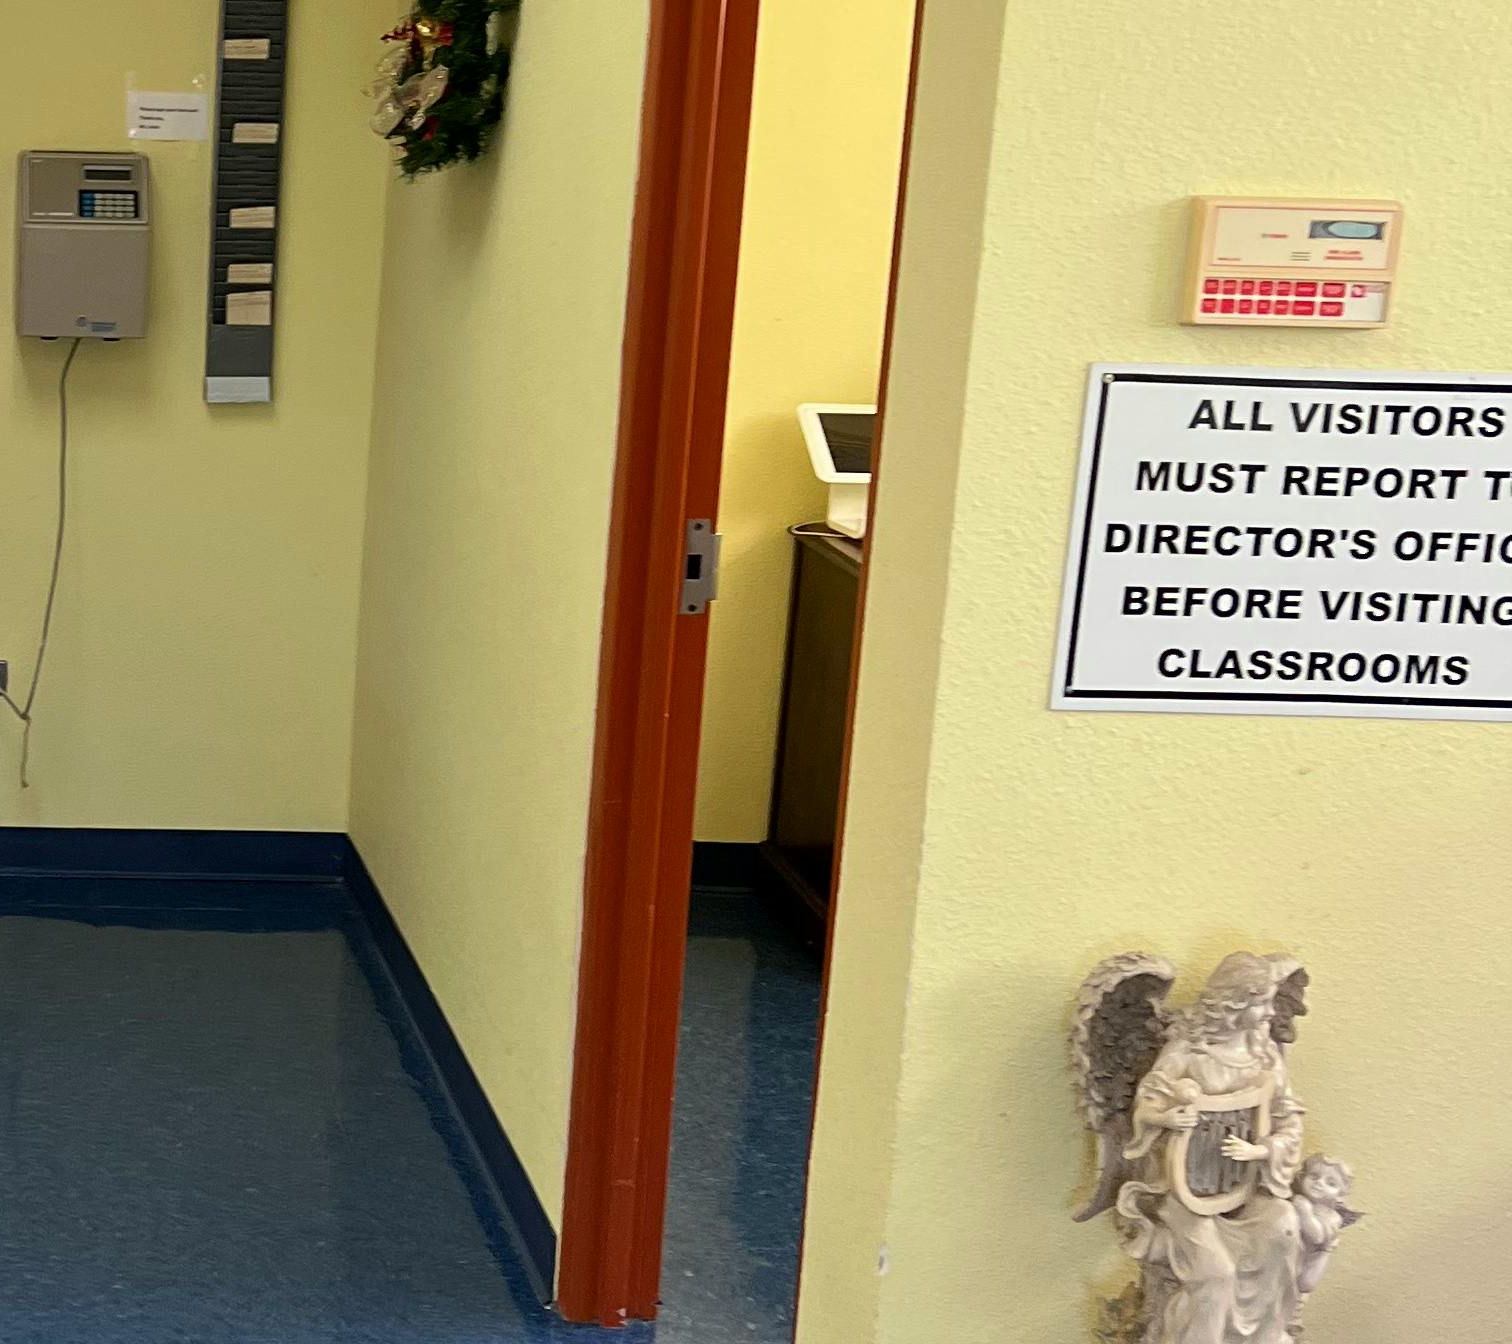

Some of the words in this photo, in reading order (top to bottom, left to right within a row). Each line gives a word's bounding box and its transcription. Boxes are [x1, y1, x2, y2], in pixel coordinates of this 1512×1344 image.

[1188, 399, 1274, 432] ALL
[1290, 402, 1506, 438] VISITORS
[1136, 460, 1267, 494] MUST
[1281, 465, 1468, 500] REPORT
[1484, 470, 1512, 501] T
[1104, 522, 1377, 560] DIRECTOR'S
[1121, 586, 1303, 620] BEFORE
[1318, 590, 1512, 626] VISITING
[1157, 648, 1470, 686] CLASSROOMS
